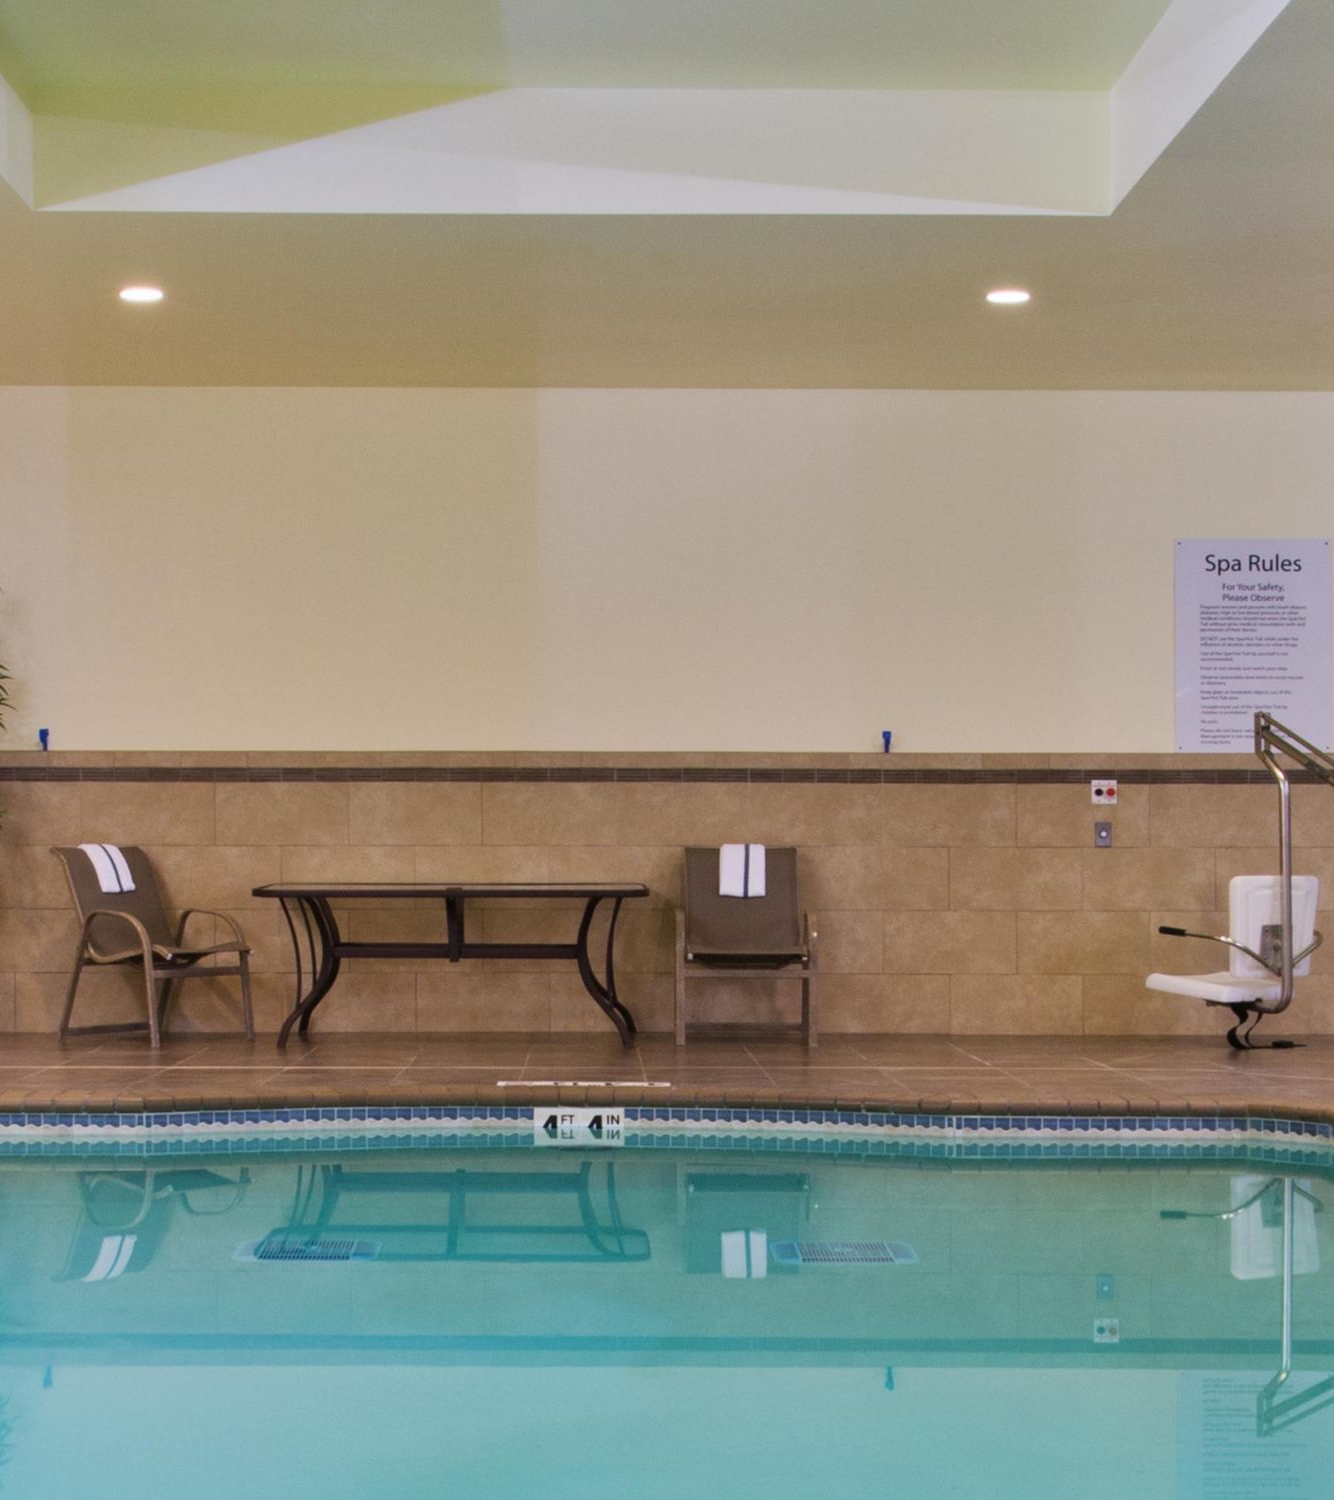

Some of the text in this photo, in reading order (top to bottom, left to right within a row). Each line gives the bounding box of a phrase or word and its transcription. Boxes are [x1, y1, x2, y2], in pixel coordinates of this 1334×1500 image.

[1205, 554, 1302, 576] Spa Rules
[1222, 583, 1235, 591] For
[1237, 583, 1255, 591] Your
[1222, 594, 1285, 602] Please Observe
[561, 1115, 575, 1125] FT
[606, 1115, 620, 1125] IN
